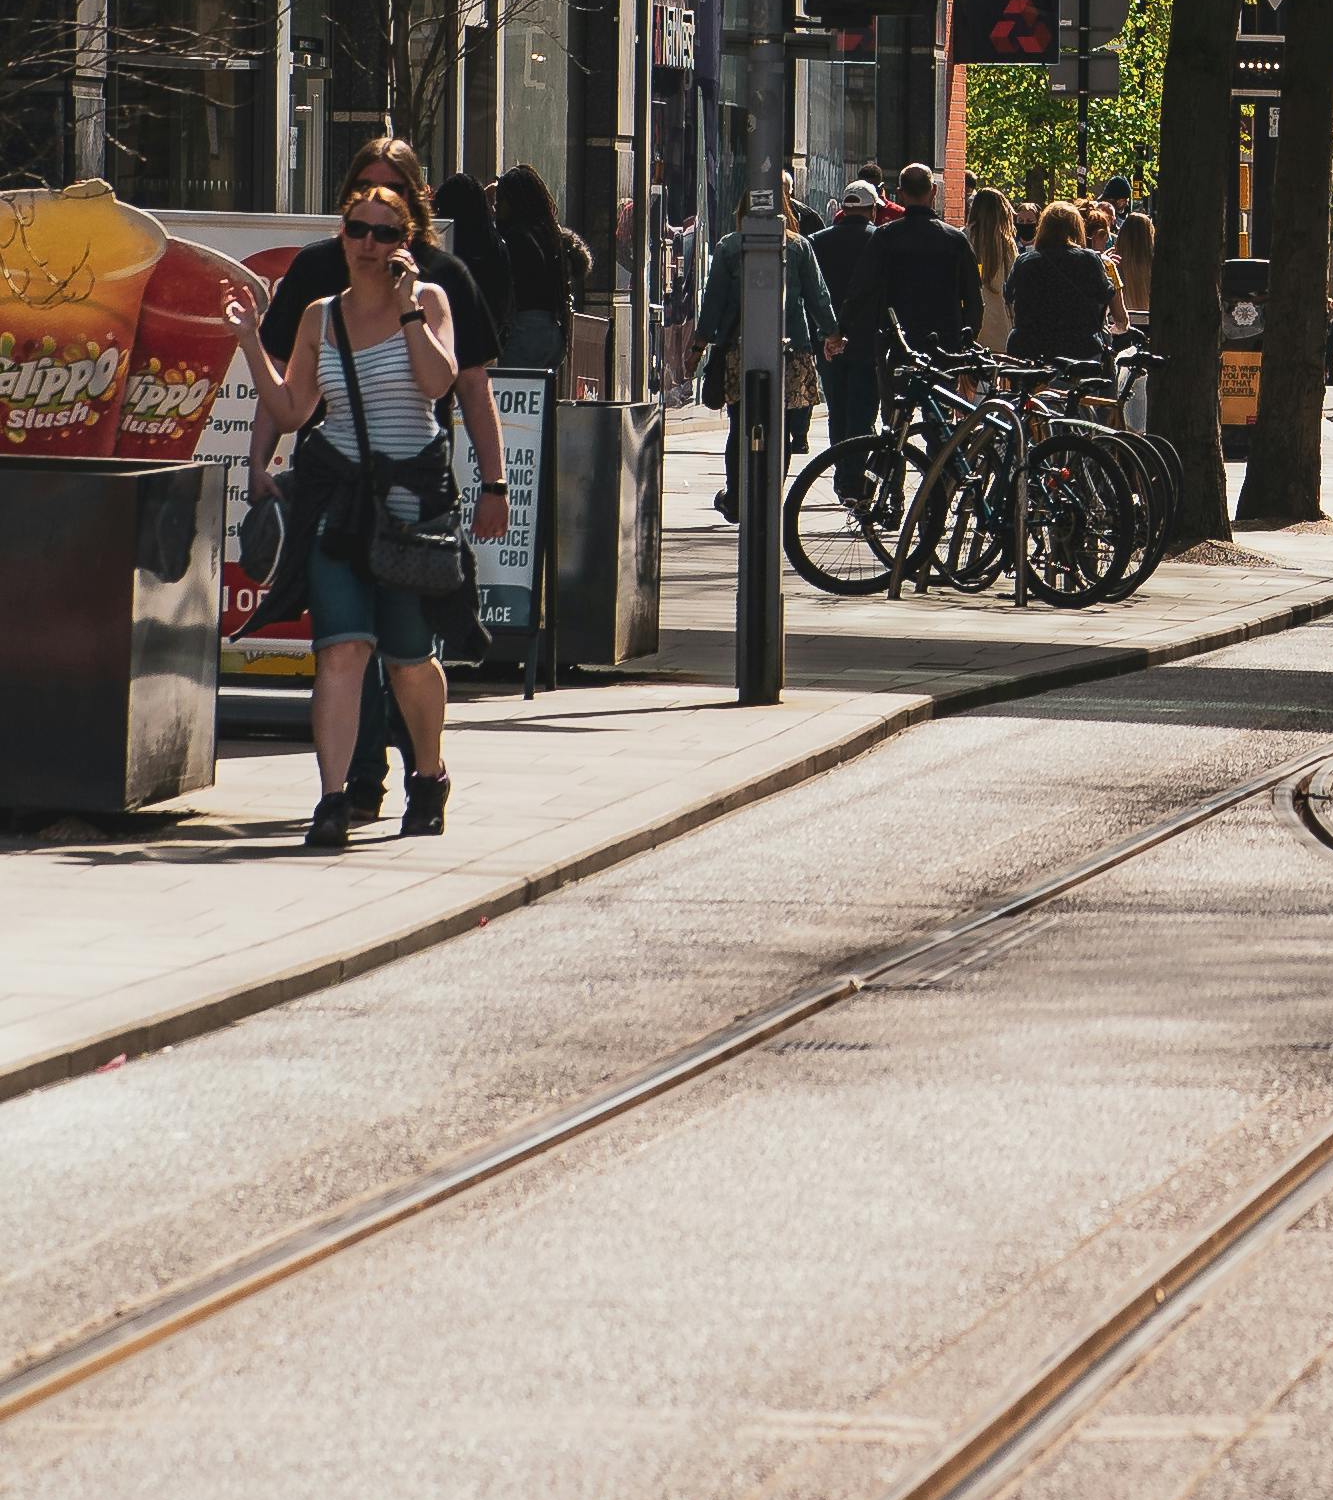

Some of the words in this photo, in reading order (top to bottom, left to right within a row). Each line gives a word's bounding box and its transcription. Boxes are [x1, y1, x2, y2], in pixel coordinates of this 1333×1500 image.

[7, 401, 90, 429] Slush
[122, 415, 178, 435] lush
[498, 550, 529, 568] CBD
